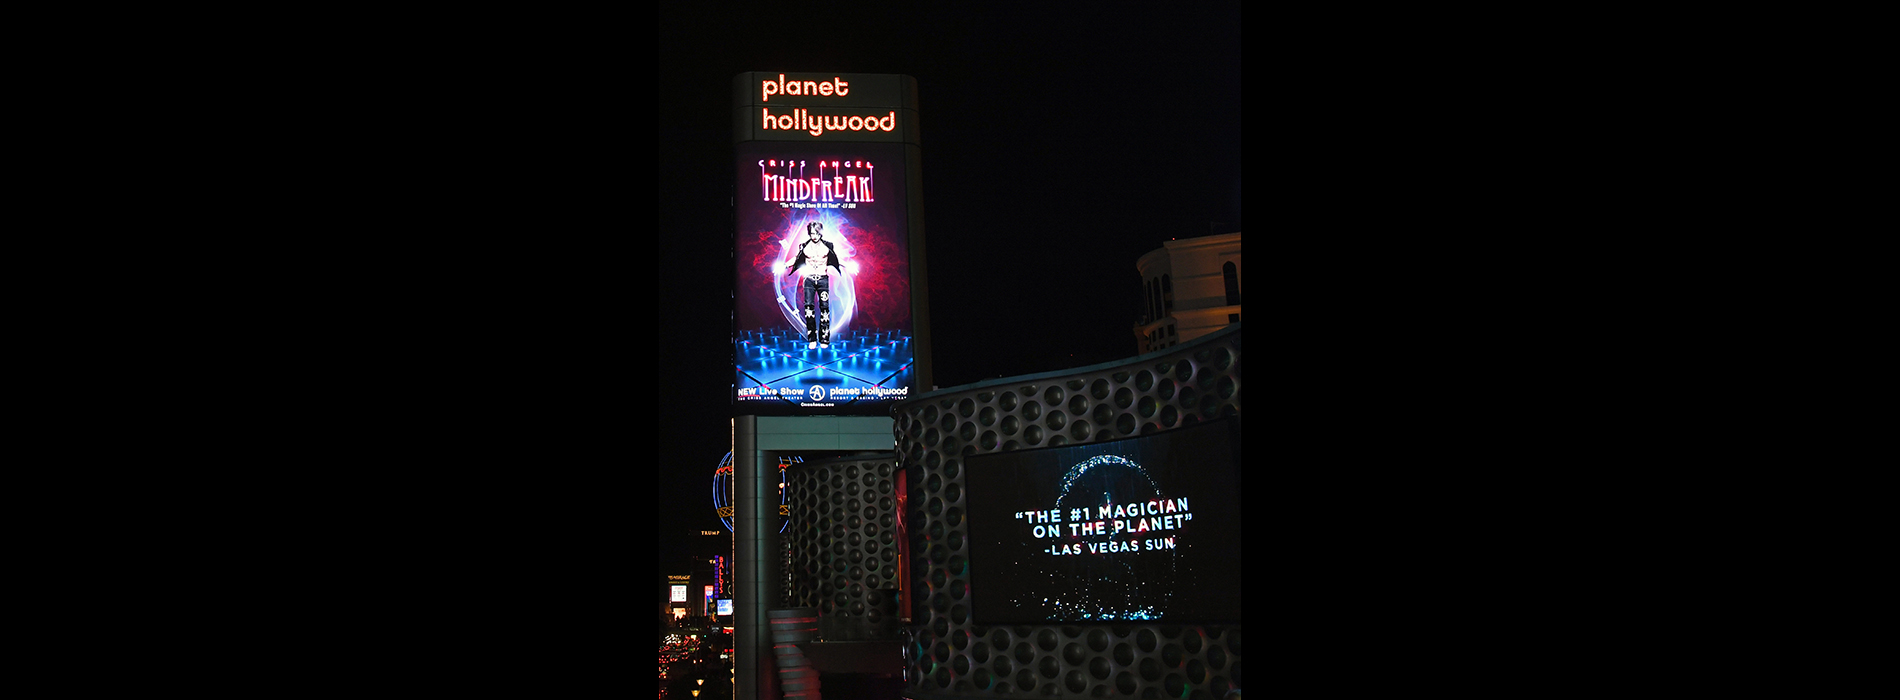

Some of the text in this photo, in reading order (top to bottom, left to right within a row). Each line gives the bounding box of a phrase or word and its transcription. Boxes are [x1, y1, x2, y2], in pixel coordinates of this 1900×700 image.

[762, 73, 849, 102] planet
[762, 107, 896, 137] hollywood
[758, 159, 874, 168] CRISS ANGEL
[738, 387, 804, 396] NEW Live Show
[829, 386, 908, 397] planet hollywood
[1069, 507, 1091, 521] #1
[1098, 497, 1189, 520] MAGICIAN
[1033, 524, 1061, 538] ON
[1069, 521, 1106, 536] THE
[1044, 537, 1174, 556] -LAS VEGAS SUN
